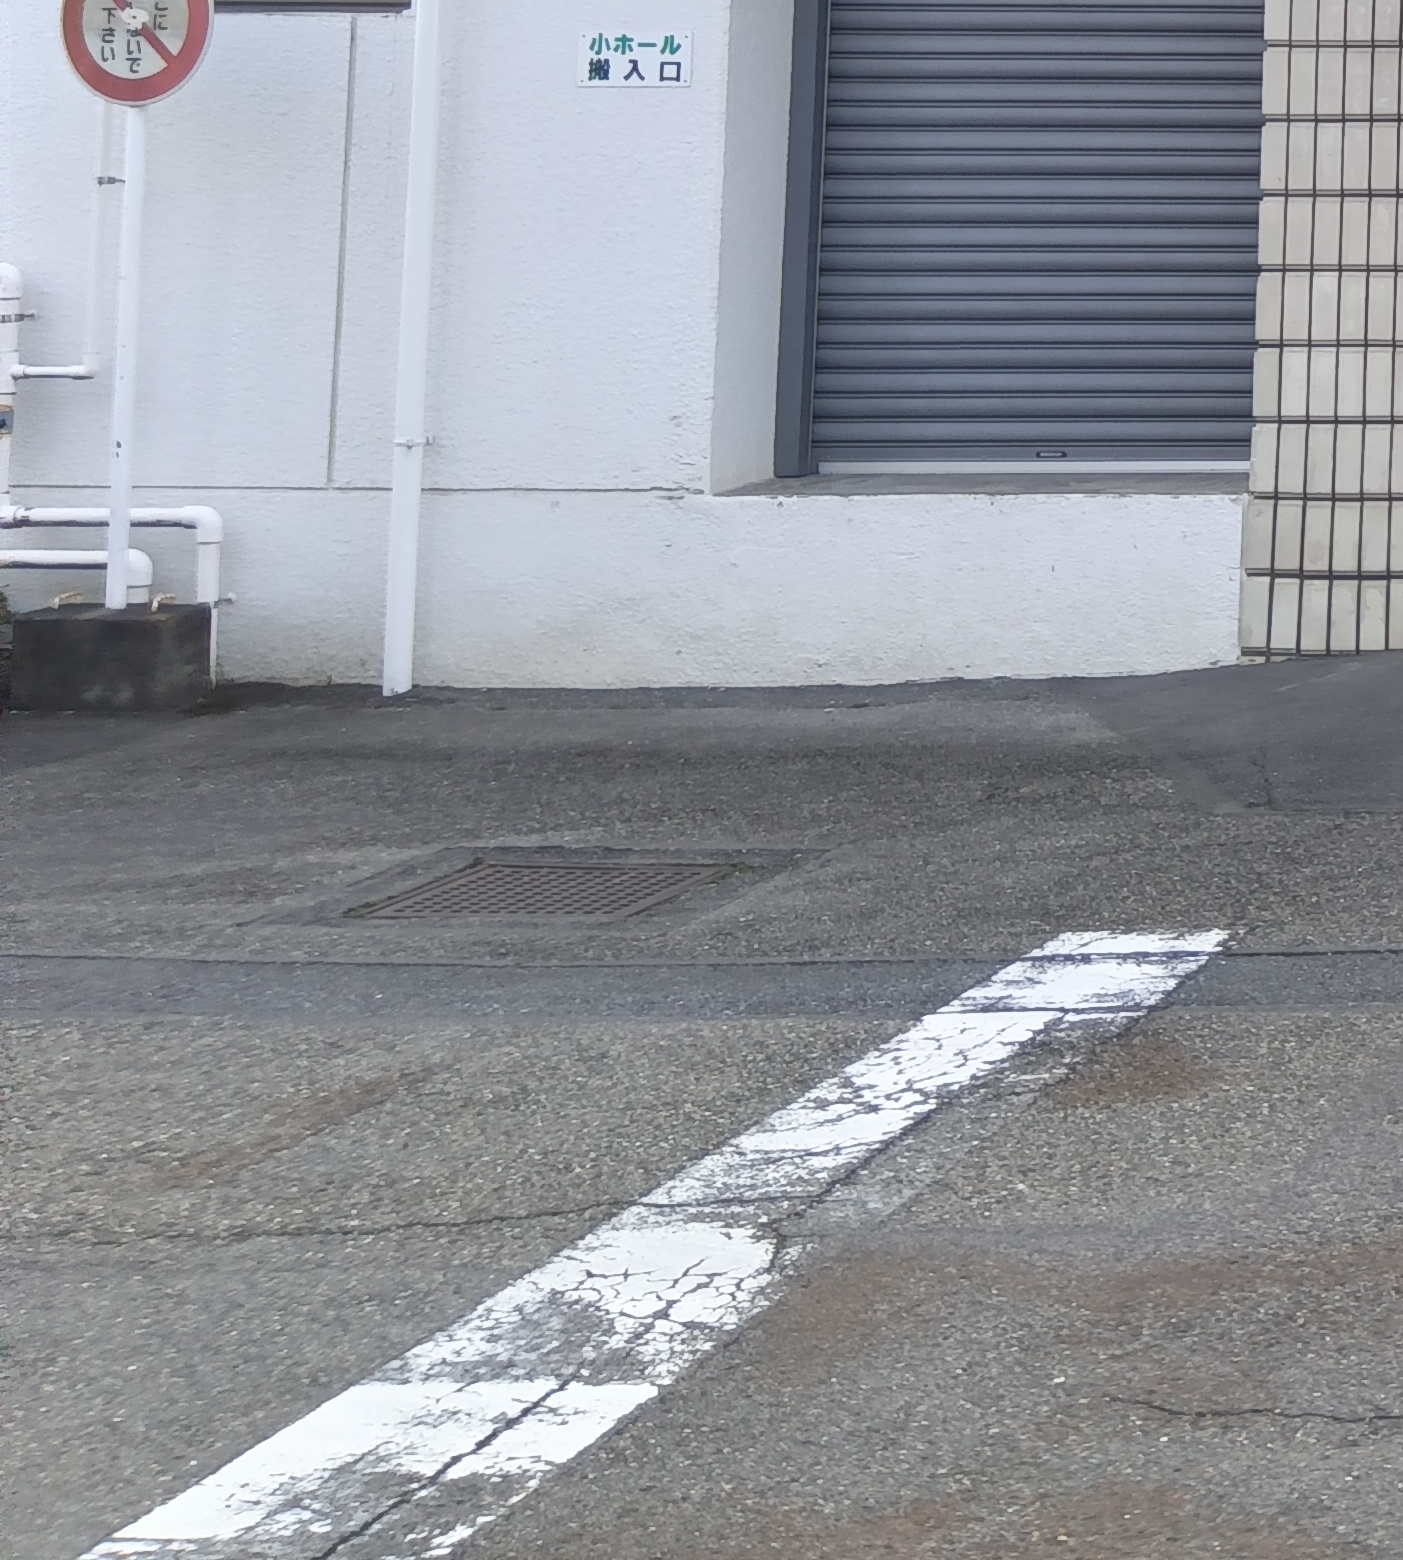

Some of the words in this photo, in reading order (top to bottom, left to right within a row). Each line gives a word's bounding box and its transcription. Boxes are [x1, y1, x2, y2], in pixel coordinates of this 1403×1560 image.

[101, 7, 118, 62] 下さい
[589, 32, 682, 55] 小ホール
[588, 58, 682, 82] 搬入口
